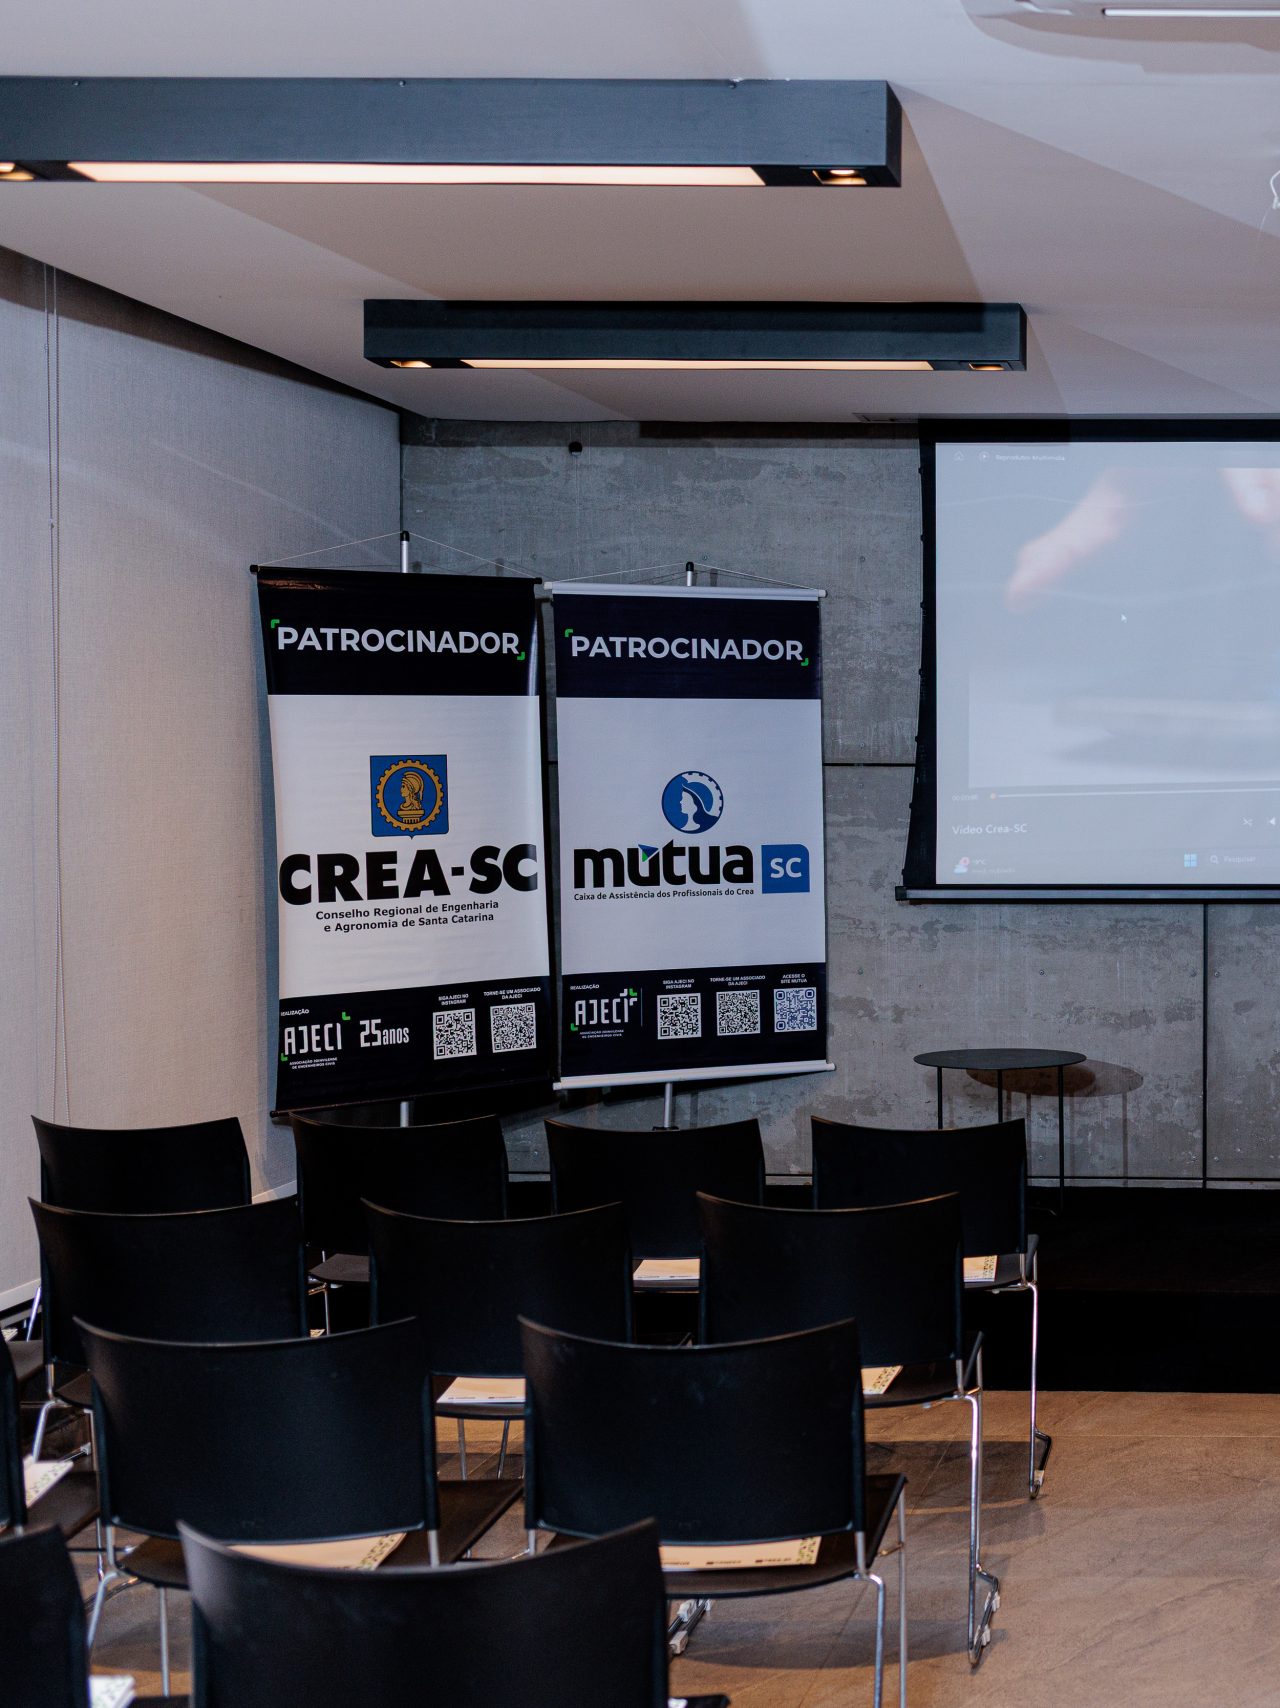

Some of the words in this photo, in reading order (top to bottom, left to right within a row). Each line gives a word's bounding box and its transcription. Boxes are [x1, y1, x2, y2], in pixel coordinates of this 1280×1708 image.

[278, 626, 520, 655] PATROCINADOR
[571, 635, 804, 661] PATROCINADOR
[985, 823, 1028, 835] Crea-SC
[279, 843, 538, 905] CREA-SC
[770, 857, 802, 879] SC
[574, 892, 595, 901] Caixa
[597, 892, 608, 900] de
[609, 890, 655, 900] Assistência
[657, 890, 671, 898] dos
[673, 888, 723, 898] Profissionais
[725, 888, 735, 896] do
[736, 888, 754, 896] Crea
[316, 908, 370, 921] Conselho
[374, 905, 422, 918] Regional
[426, 904, 439, 914] de
[442, 900, 500, 913] Engenharia
[324, 924, 331, 932] e
[335, 919, 398, 933] Agronomia
[402, 918, 416, 928] de
[419, 916, 449, 926] Santa
[452, 913, 495, 924] Catarina
[575, 998, 629, 1026] AJECI
[284, 1022, 343, 1056] AJECI
